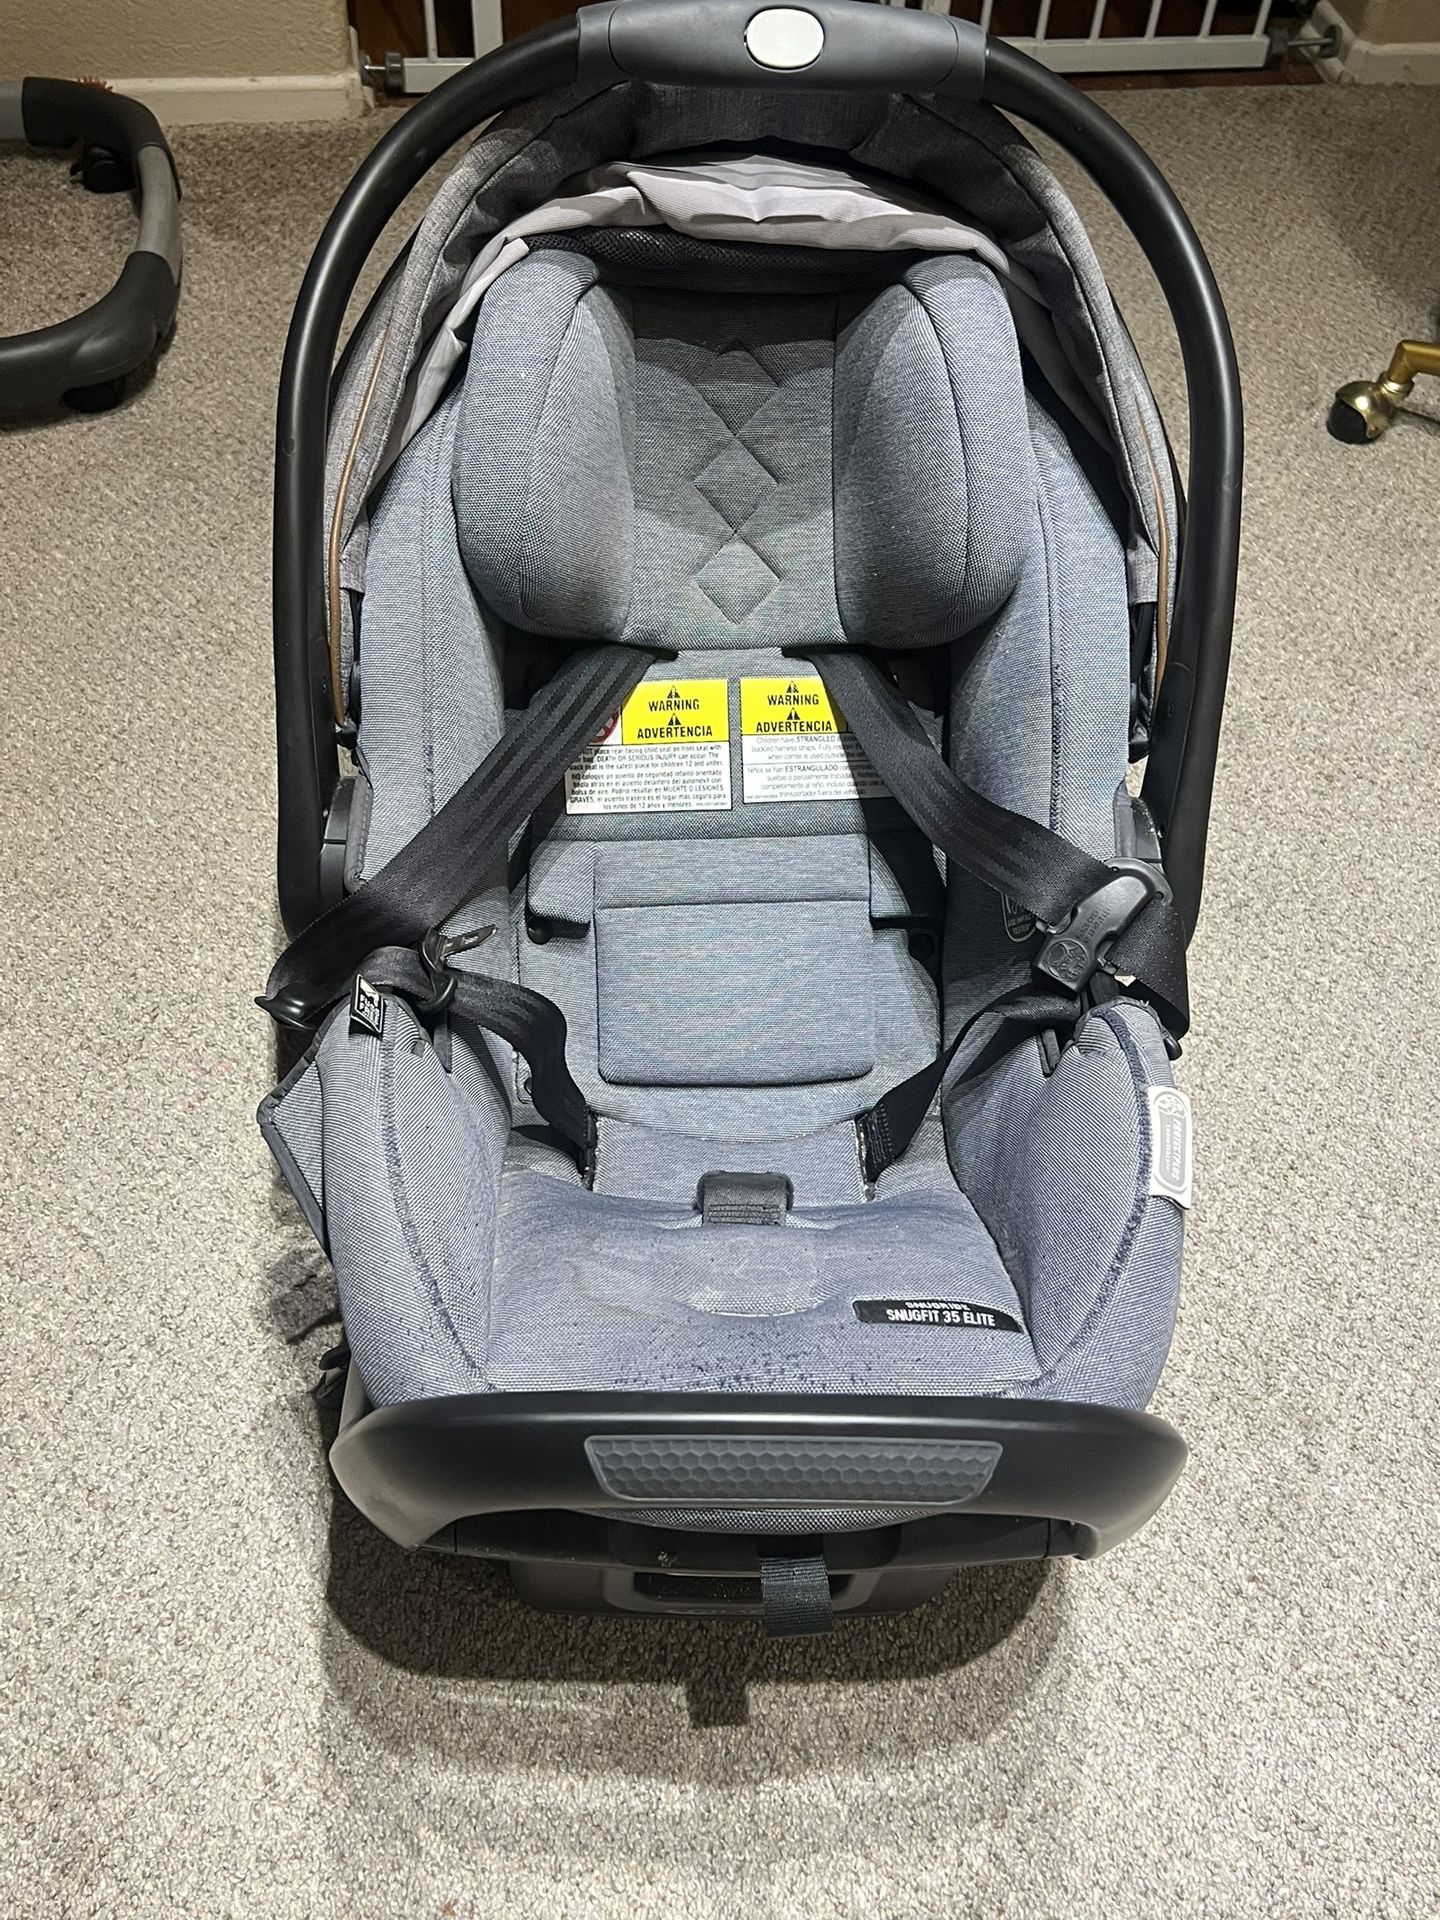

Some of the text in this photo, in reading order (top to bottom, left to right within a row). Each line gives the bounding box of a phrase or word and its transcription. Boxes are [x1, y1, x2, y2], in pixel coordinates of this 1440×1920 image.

[648, 699, 700, 712] WARNING
[768, 694, 819, 706] WARNING
[637, 726, 713, 739] ADVERTENCIA
[756, 720, 832, 733] ADVERTENCIA
[886, 1309, 996, 1326] SNUGFIT 35 ELITE
